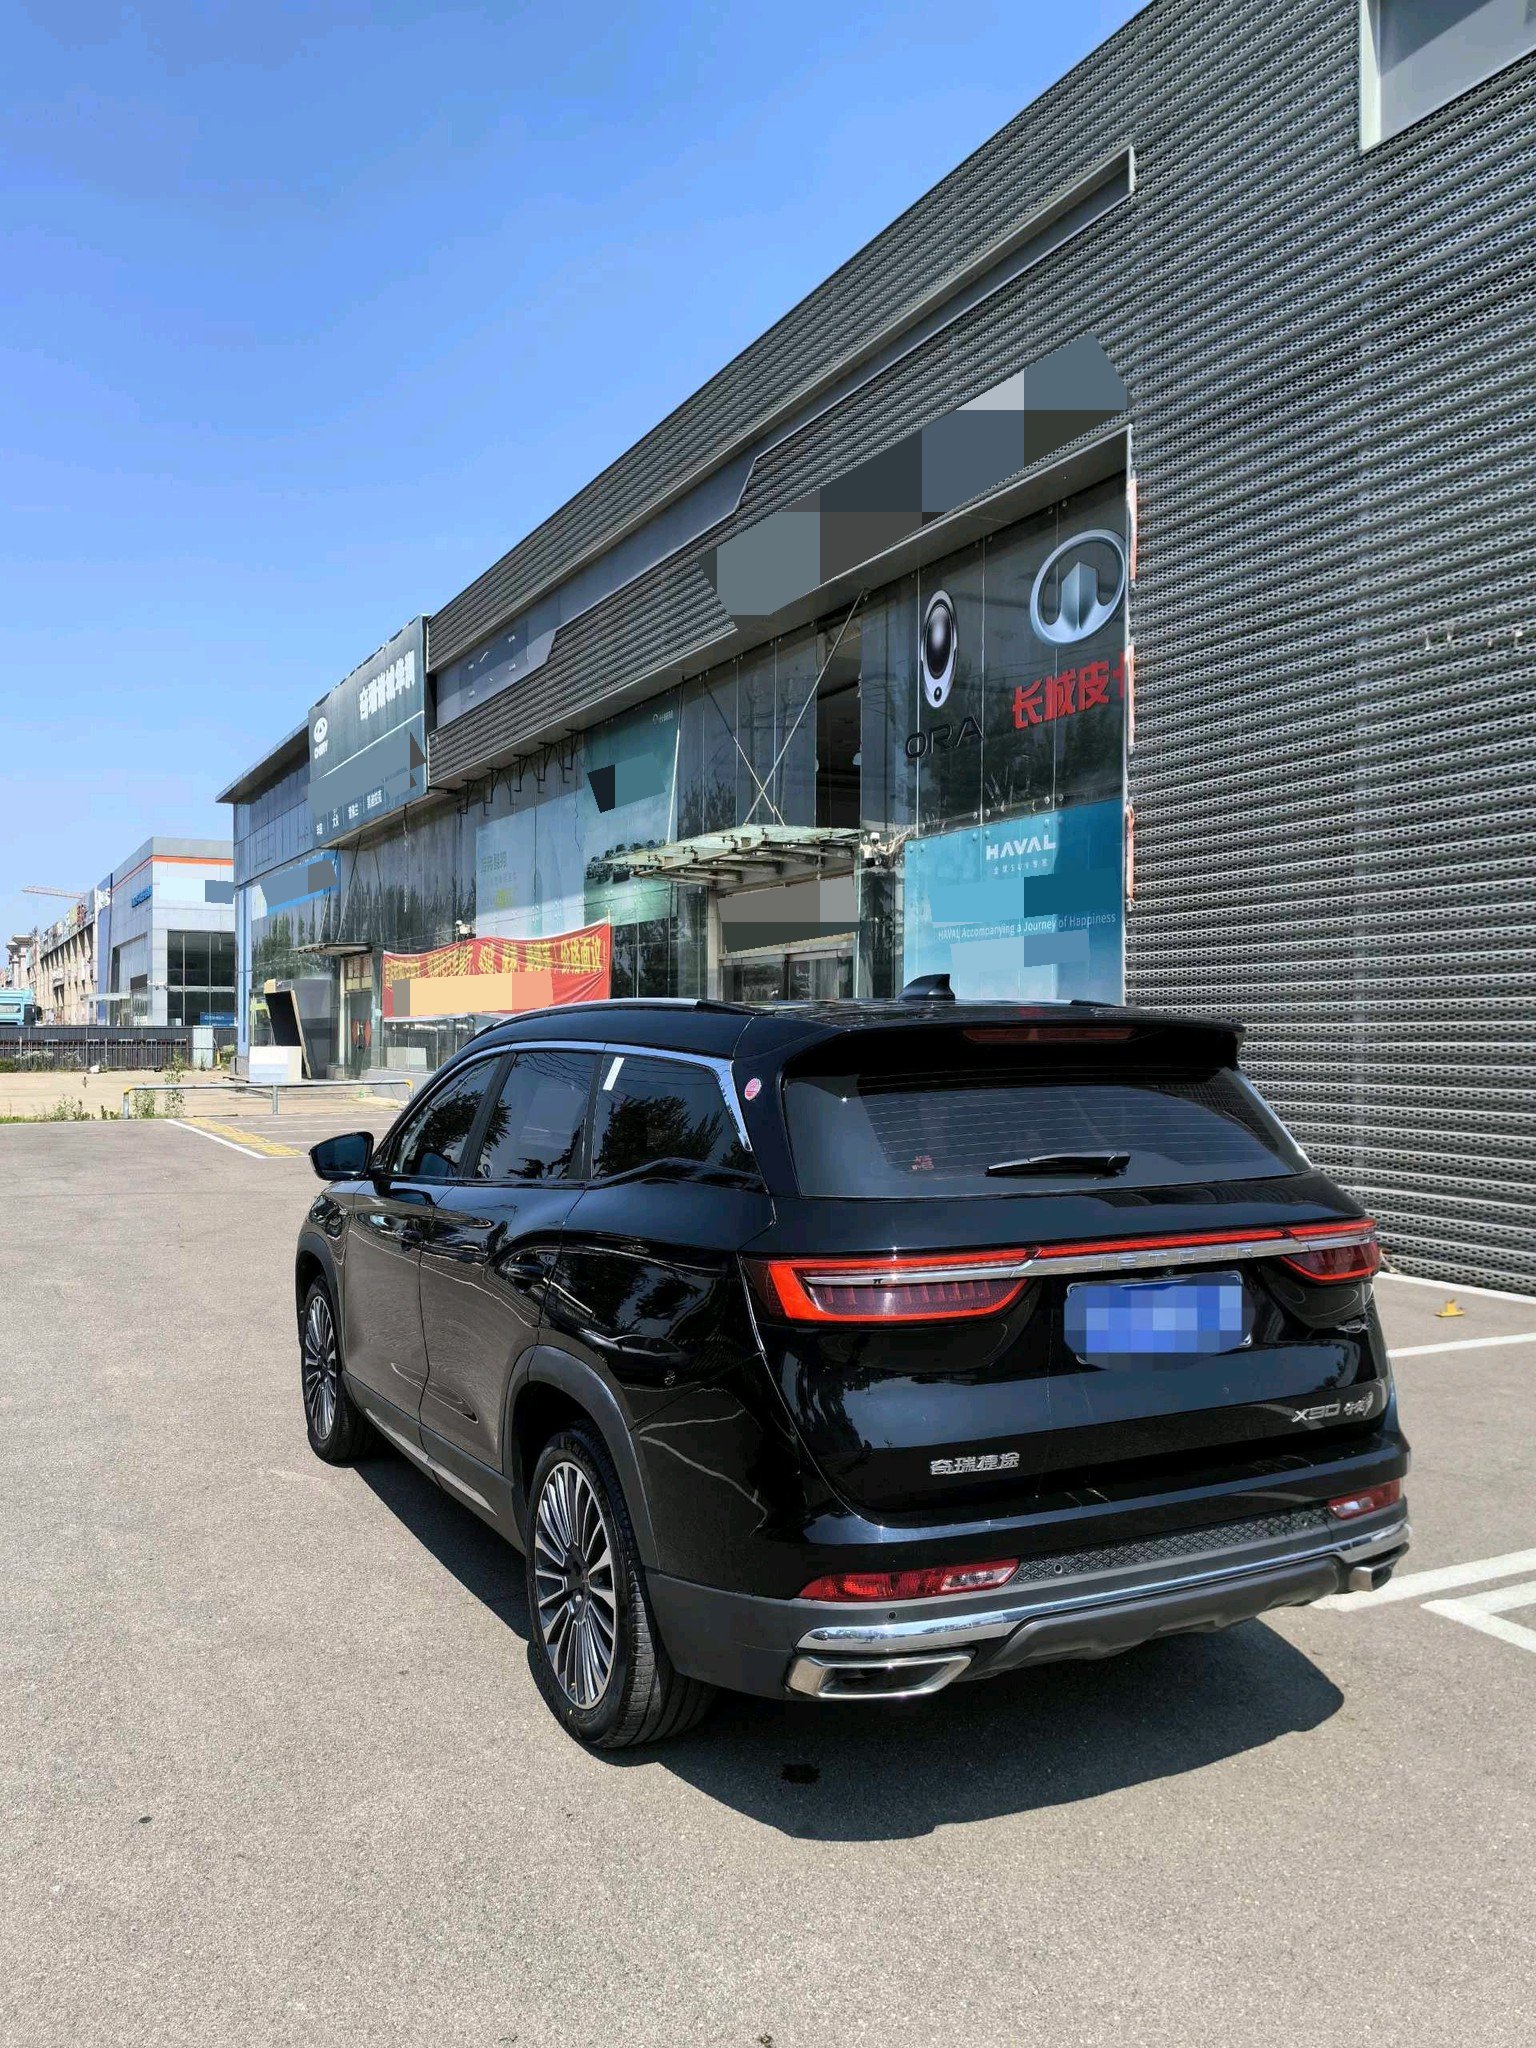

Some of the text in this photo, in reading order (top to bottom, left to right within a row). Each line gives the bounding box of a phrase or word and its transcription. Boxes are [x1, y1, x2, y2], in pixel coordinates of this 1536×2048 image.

[906, 714, 984, 758] ORA
[986, 834, 1057, 861] HAVAL
[938, 928, 961, 941] HAVAL
[962, 924, 1016, 938] Accompanying
[1023, 917, 1057, 934] Journey
[1058, 917, 1068, 928] of
[1069, 911, 1117, 930] Happiness
[1291, 1403, 1341, 1423] X90
[929, 1452, 1020, 1476] 奇瑞捷途
